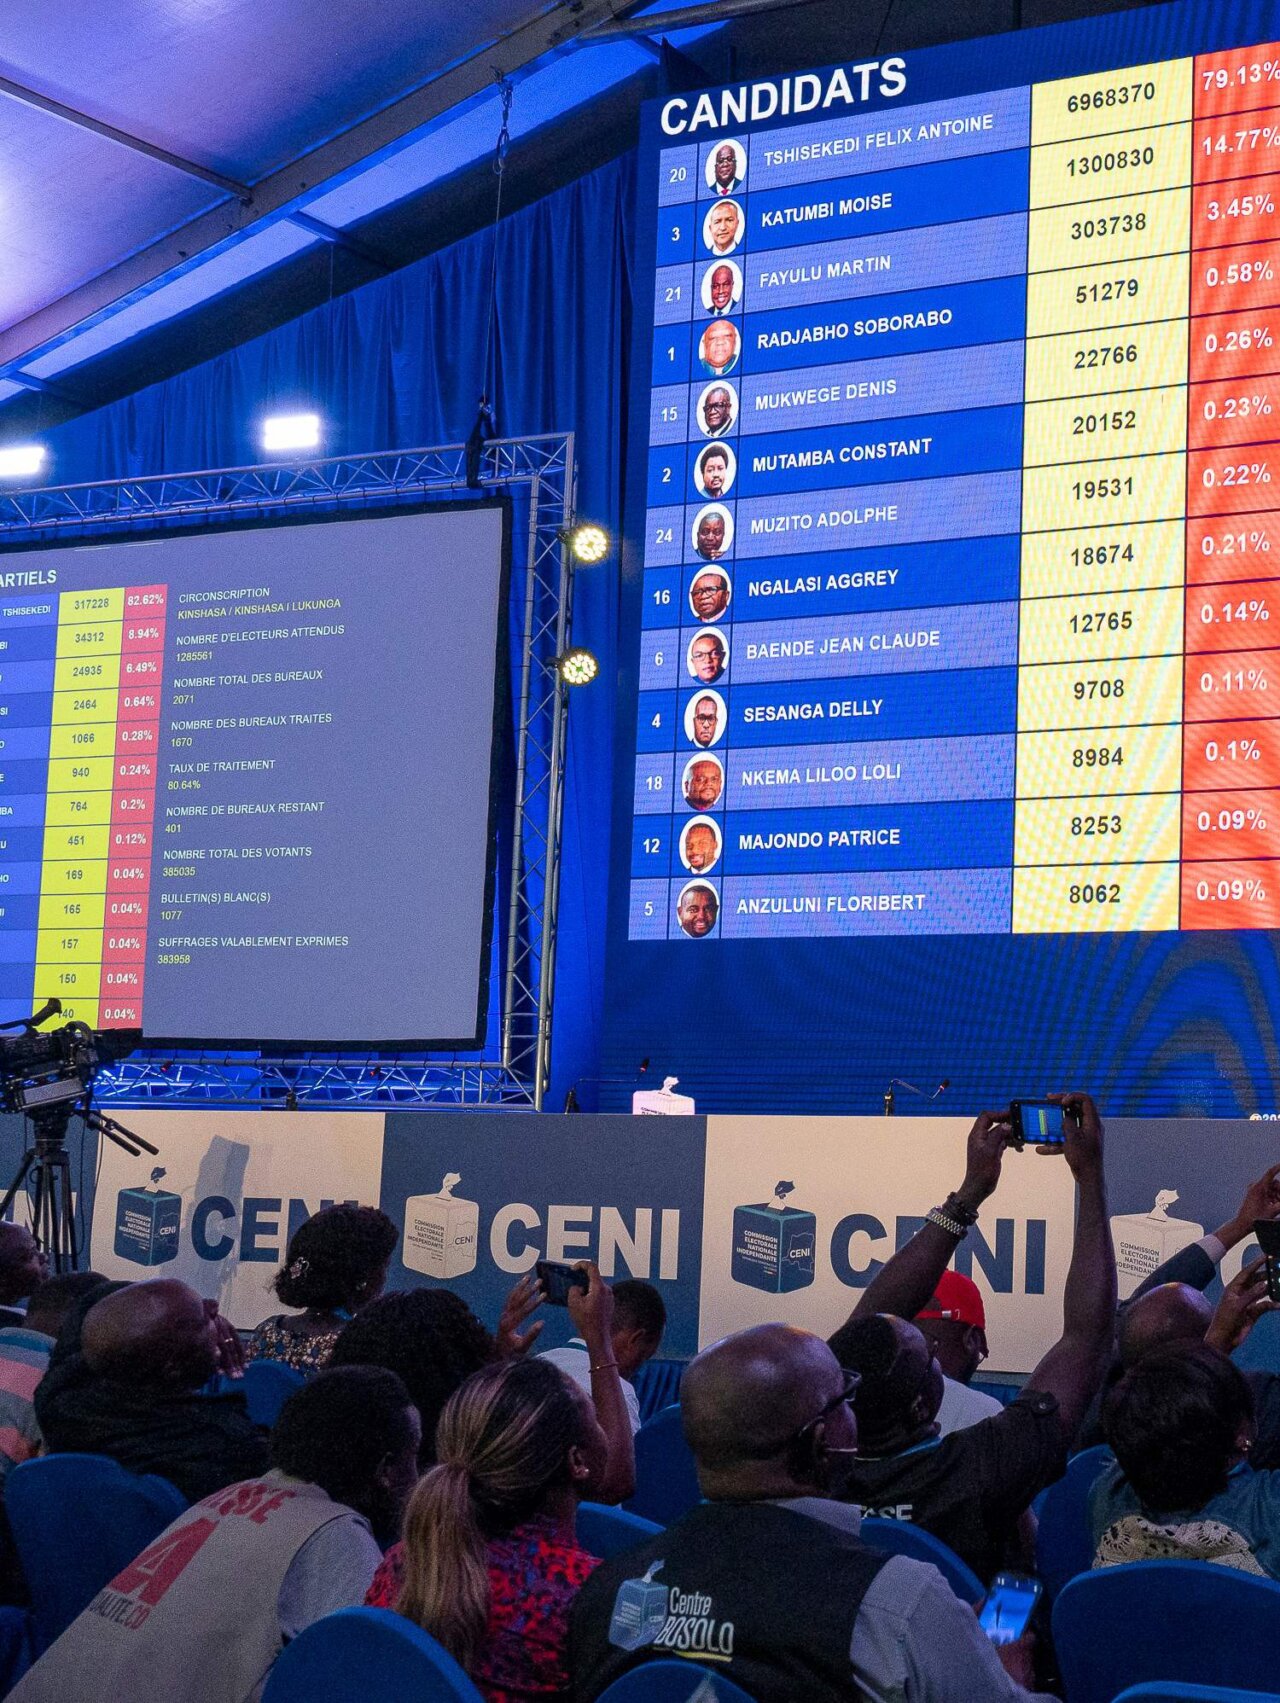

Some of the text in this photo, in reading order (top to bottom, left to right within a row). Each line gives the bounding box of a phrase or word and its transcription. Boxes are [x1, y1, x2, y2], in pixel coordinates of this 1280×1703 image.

[661, 57, 907, 135] CANDIDATS
[670, 167, 686, 182] 20
[765, 137, 859, 165] TSHISEKEDI
[866, 128, 911, 149] FELIX
[918, 115, 992, 140] ANTOINE
[1068, 82, 1155, 112] 6968370
[672, 227, 679, 241] 3
[762, 203, 833, 226] KATUMBI
[840, 193, 891, 214] MOISE
[1067, 147, 1153, 176] 1300830
[666, 195, 1274, 301] 21 FAYULU MARTIN 303738 3.45%
[669, 261, 1273, 360] 1 RADJABHO SOBORABO 51279 0.58%
[662, 328, 1272, 421] 15 MUKWEGE DENIS 22766 0.26%
[663, 396, 1271, 482] 2 MUTAMBA CONSTANT 20152 0.23%
[656, 464, 1270, 543] 24 MUZITO ADOLPHE 19531 0.22%
[654, 532, 1269, 604] 16 NGALASI AGGREY 18674 0.21%
[179, 587, 270, 604] CIRCONSCRIPTION
[3, 594, 163, 616] TSHISEKEDI 317228 82.62%
[177, 625, 344, 645] NOMBRE D'ELECTEURS ATTENDUS
[655, 601, 1269, 665] 6 BAENDE JEAN CLAUDE 12765 0.14%
[177, 651, 212, 661] 1285561
[174, 670, 322, 687] NOMBRE TOTAL DES BUREAUX
[173, 695, 193, 704] 2071
[652, 670, 1267, 727] 4 SESANGA DELLY 9708 0.11%
[172, 713, 331, 730] NOMBRE DES BUREAUX TRAITES
[172, 737, 192, 747] 1670
[170, 760, 275, 772] TAUX DE TRAITEMENT
[647, 741, 1260, 790] 18 NKEMA LILOO LOLI 8984 0.1%
[168, 780, 200, 789] 80.64%
[644, 809, 1266, 852] 12 MAJONDO PATRICE 8253 0.09%
[161, 892, 270, 904] BULLETIN(S) BLANC(S)
[645, 879, 1265, 915] 5 ANZULUNI FLORIBERT 8062 0.09%
[161, 911, 182, 920] 1077
[159, 936, 348, 947] SUFFRAGES VALABLEMENT EXPRIMES
[158, 955, 190, 964] 383958
[160, 1226, 176, 1235] CENI
[192, 1196, 358, 1262] CE
[744, 1230, 778, 1243] COMMISSION
[455, 1235, 473, 1245] CENI
[490, 1203, 680, 1280] CENI
[745, 1237, 777, 1249] ELECTORALE
[737, 1247, 777, 1262] INDEPENDANTE
[748, 1244, 777, 1256] NATIONALE
[790, 1248, 810, 1258] CENI
[1120, 1242, 1159, 1256] COMMISSION
[1121, 1249, 1159, 1264] ELECTORALE
[670, 1587, 712, 1616] Centre
[654, 1616, 734, 1654] BOSOLO
